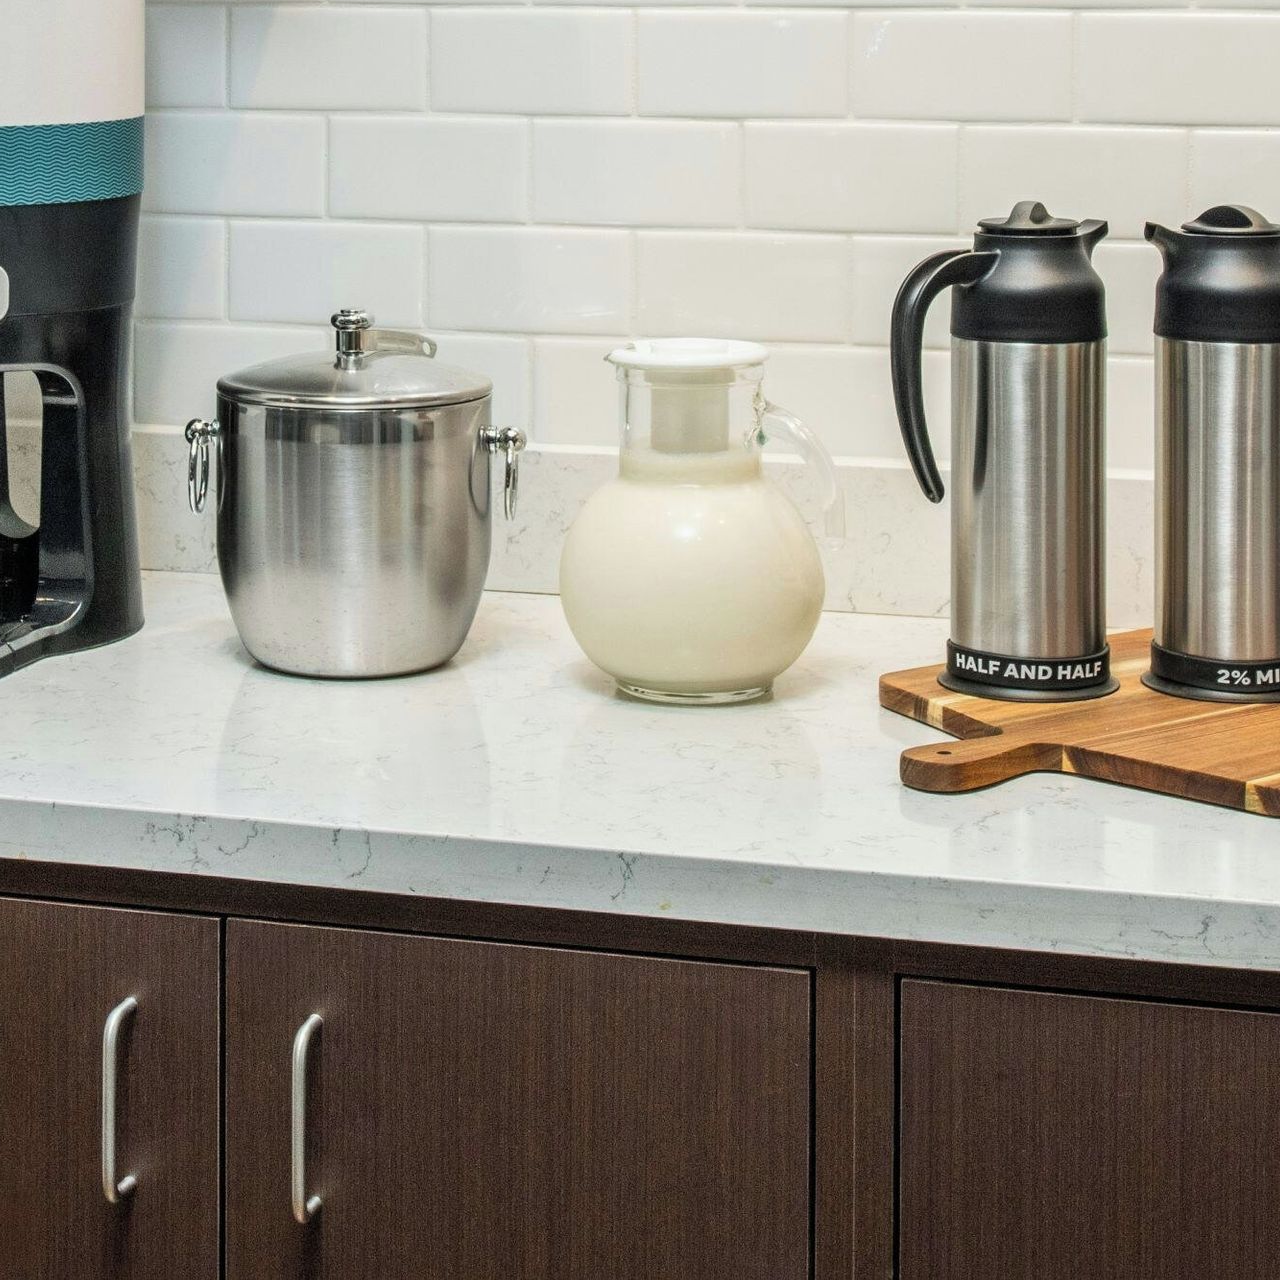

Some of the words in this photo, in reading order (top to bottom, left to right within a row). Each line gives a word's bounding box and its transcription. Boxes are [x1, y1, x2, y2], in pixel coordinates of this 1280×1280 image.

[955, 653, 1001, 675] HALF
[1003, 663, 1053, 680] AND
[1057, 661, 1102, 680] HALF
[1216, 669, 1252, 686] 2%
